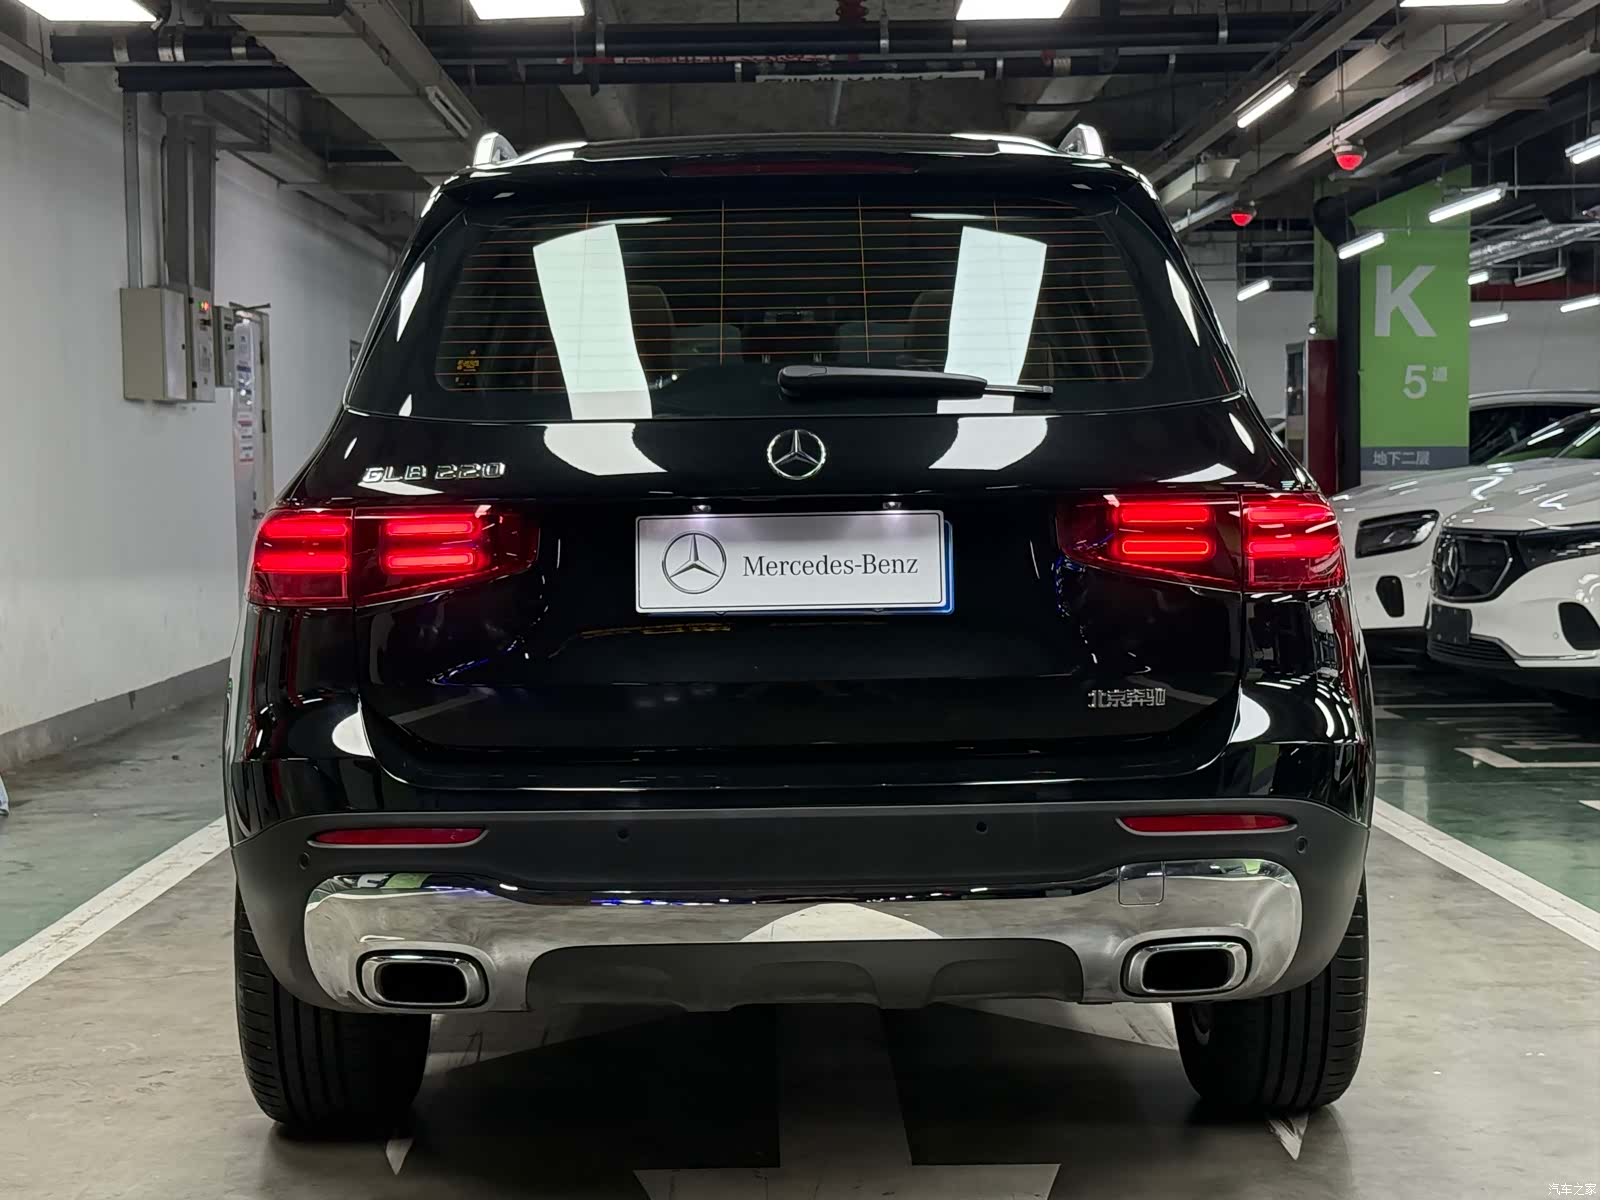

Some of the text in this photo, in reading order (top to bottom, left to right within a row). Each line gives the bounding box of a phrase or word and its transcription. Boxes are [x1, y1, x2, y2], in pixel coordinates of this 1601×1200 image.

[1374, 264, 1437, 337] K
[1402, 364, 1427, 399] 5
[1373, 450, 1430, 466] 地下二层
[362, 461, 506, 483] GLB 220
[742, 553, 919, 577] Mercedes-Benz
[1087, 687, 1167, 709] 北京奔驰
